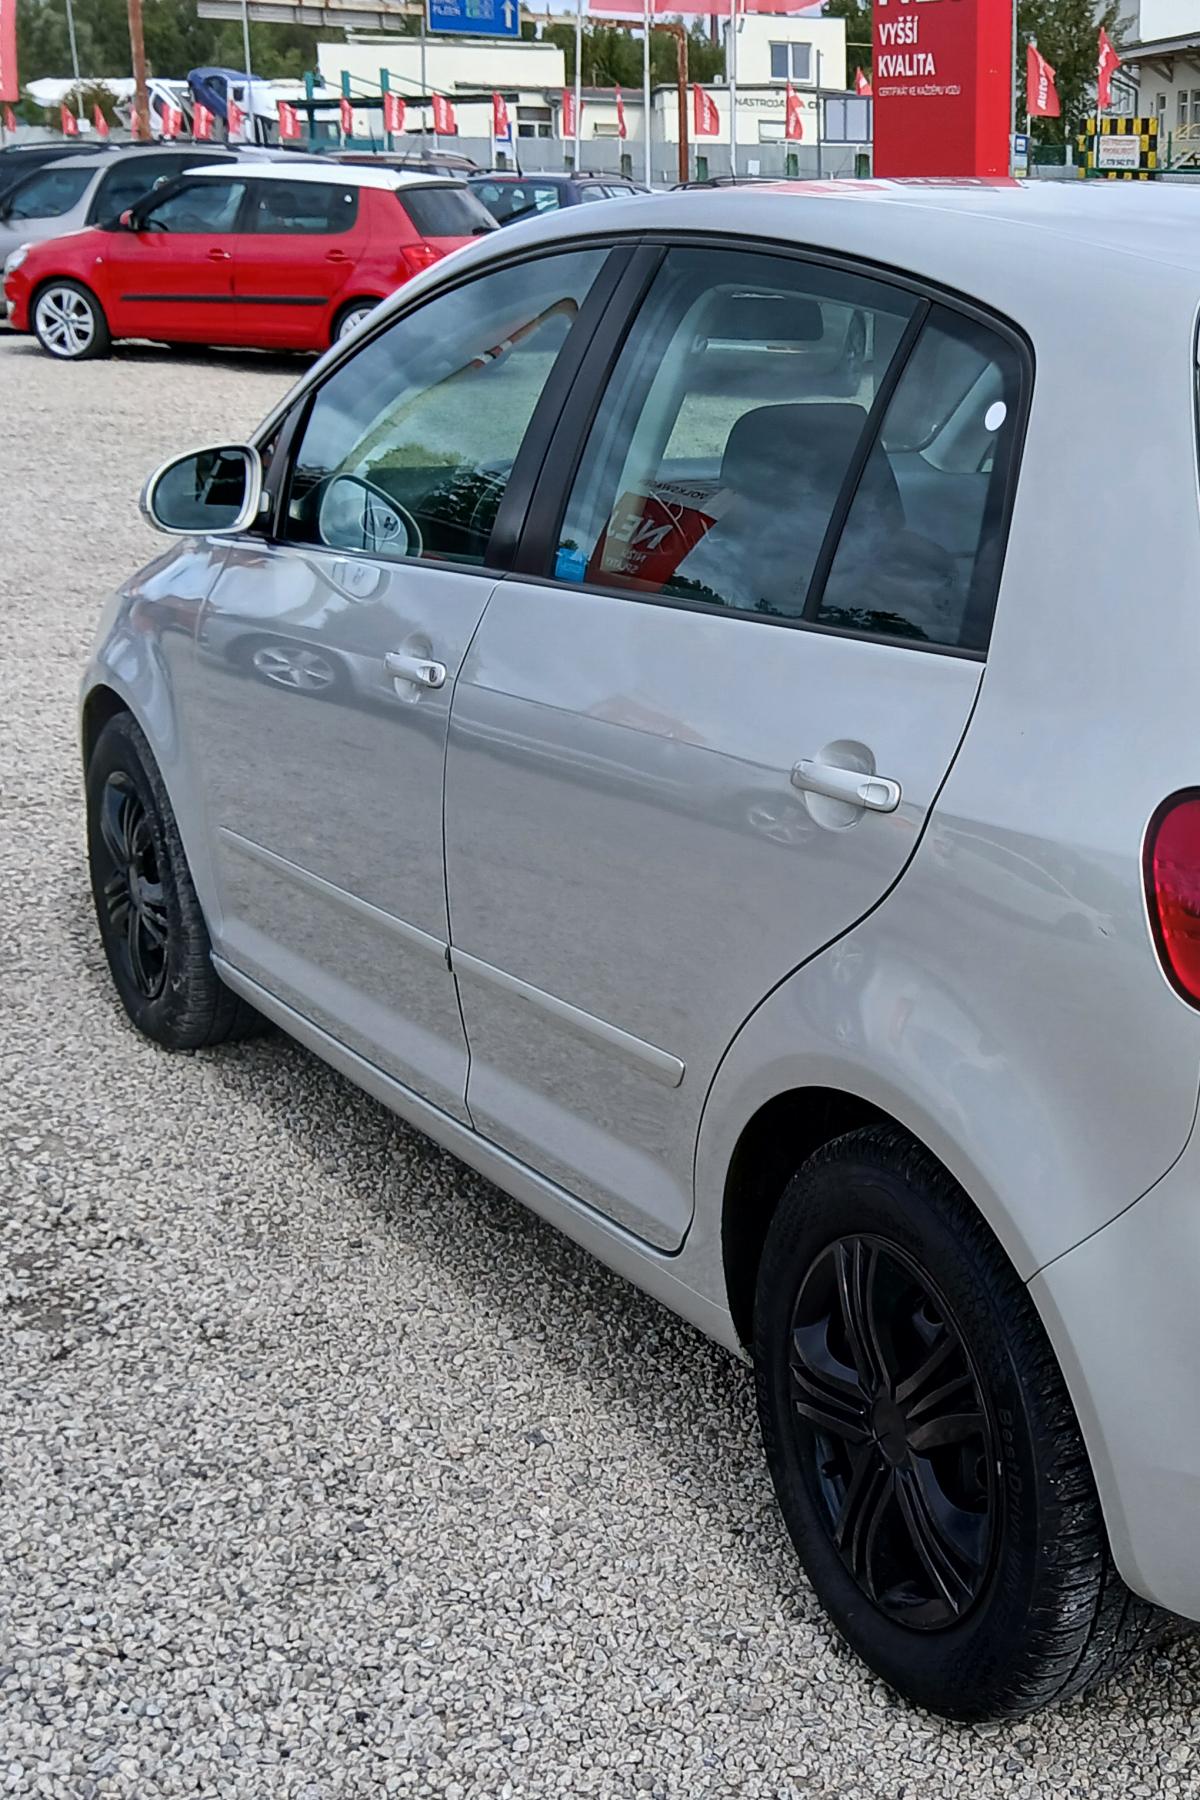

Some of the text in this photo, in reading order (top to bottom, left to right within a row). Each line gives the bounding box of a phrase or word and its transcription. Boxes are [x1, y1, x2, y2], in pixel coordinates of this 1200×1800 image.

[879, 15, 919, 45] VYŠŠÍ
[878, 53, 936, 77] KVALITA
[1037, 76, 1048, 111] Auto
